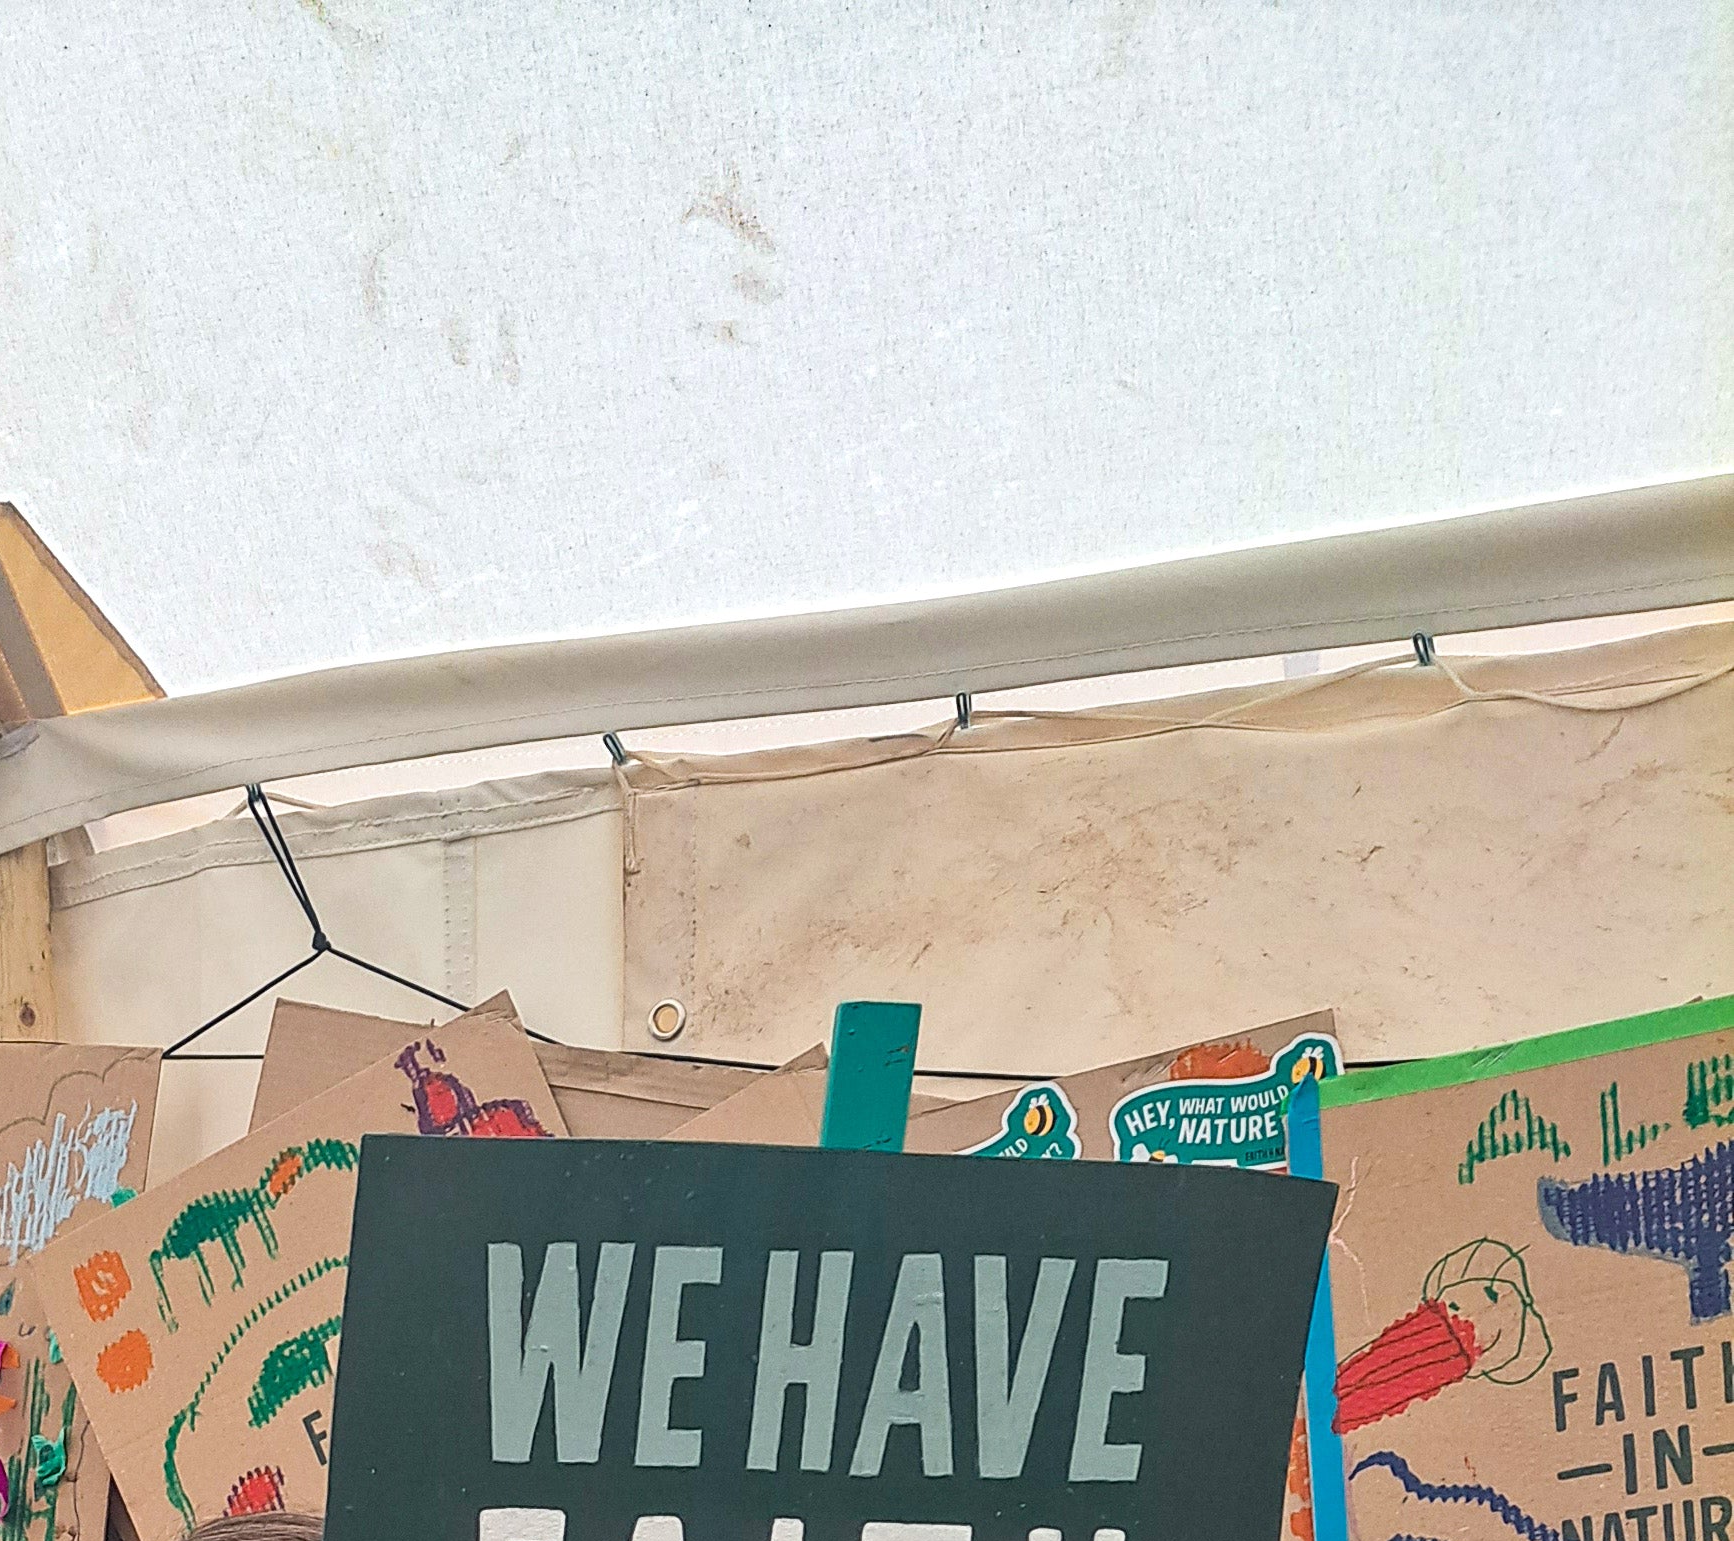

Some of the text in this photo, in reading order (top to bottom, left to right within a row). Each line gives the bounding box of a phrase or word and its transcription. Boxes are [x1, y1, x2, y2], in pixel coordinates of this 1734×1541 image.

[1123, 1085, 1289, 1137] HEY, WHAT WOULD
[1177, 1109, 1280, 1145] NATURE
[485, 1240, 1171, 1484] WE HAVE
